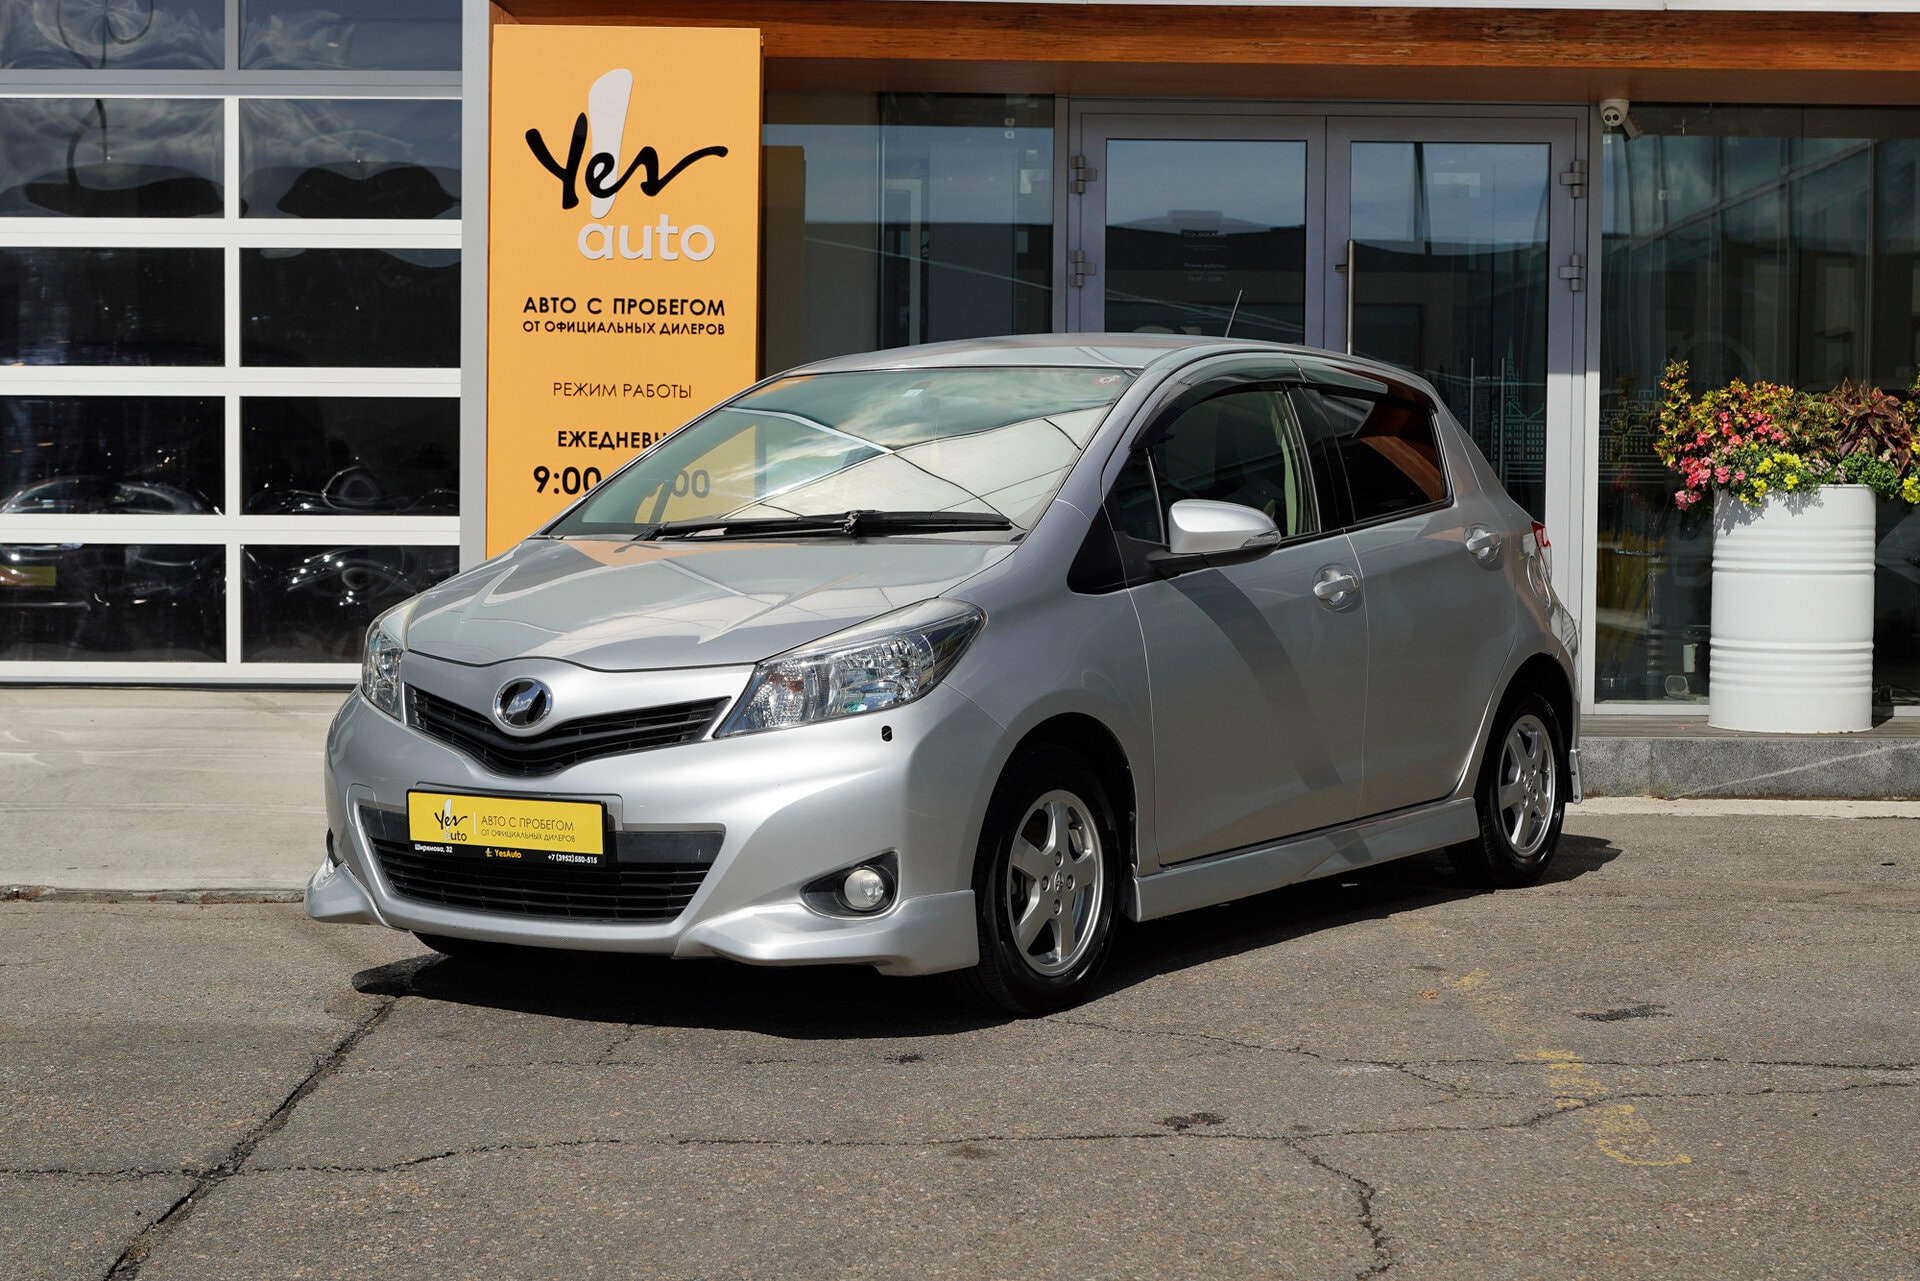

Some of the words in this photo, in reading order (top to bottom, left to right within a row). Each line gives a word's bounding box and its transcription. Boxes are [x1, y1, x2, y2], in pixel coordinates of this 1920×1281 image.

[525, 112, 728, 210] Yes
[577, 214, 715, 261] auto
[523, 297, 576, 314] АВТО
[587, 297, 603, 315] С
[613, 298, 725, 316] ПРОБЕГОМ
[522, 321, 541, 333] ОТ
[544, 321, 656, 335] ОФИЦИАЛЬНЫХ
[659, 323, 725, 336] ДИЛЕРОВ
[553, 382, 617, 398] РЕЖИМ
[623, 384, 692, 399] РАБОТЫ
[557, 430, 667, 450] ЕЖЕДНЕВН
[481, 816, 506, 827] АВТО
[509, 817, 516, 828] С
[519, 818, 574, 832] ПРОБЕГОМ
[481, 829, 489, 837] ОТ
[491, 830, 542, 841] ОФИЦИАЛЬНЫХ
[543, 834, 576, 843] ДИЛЕРОВ
[494, 849, 522, 859] YesAuto
